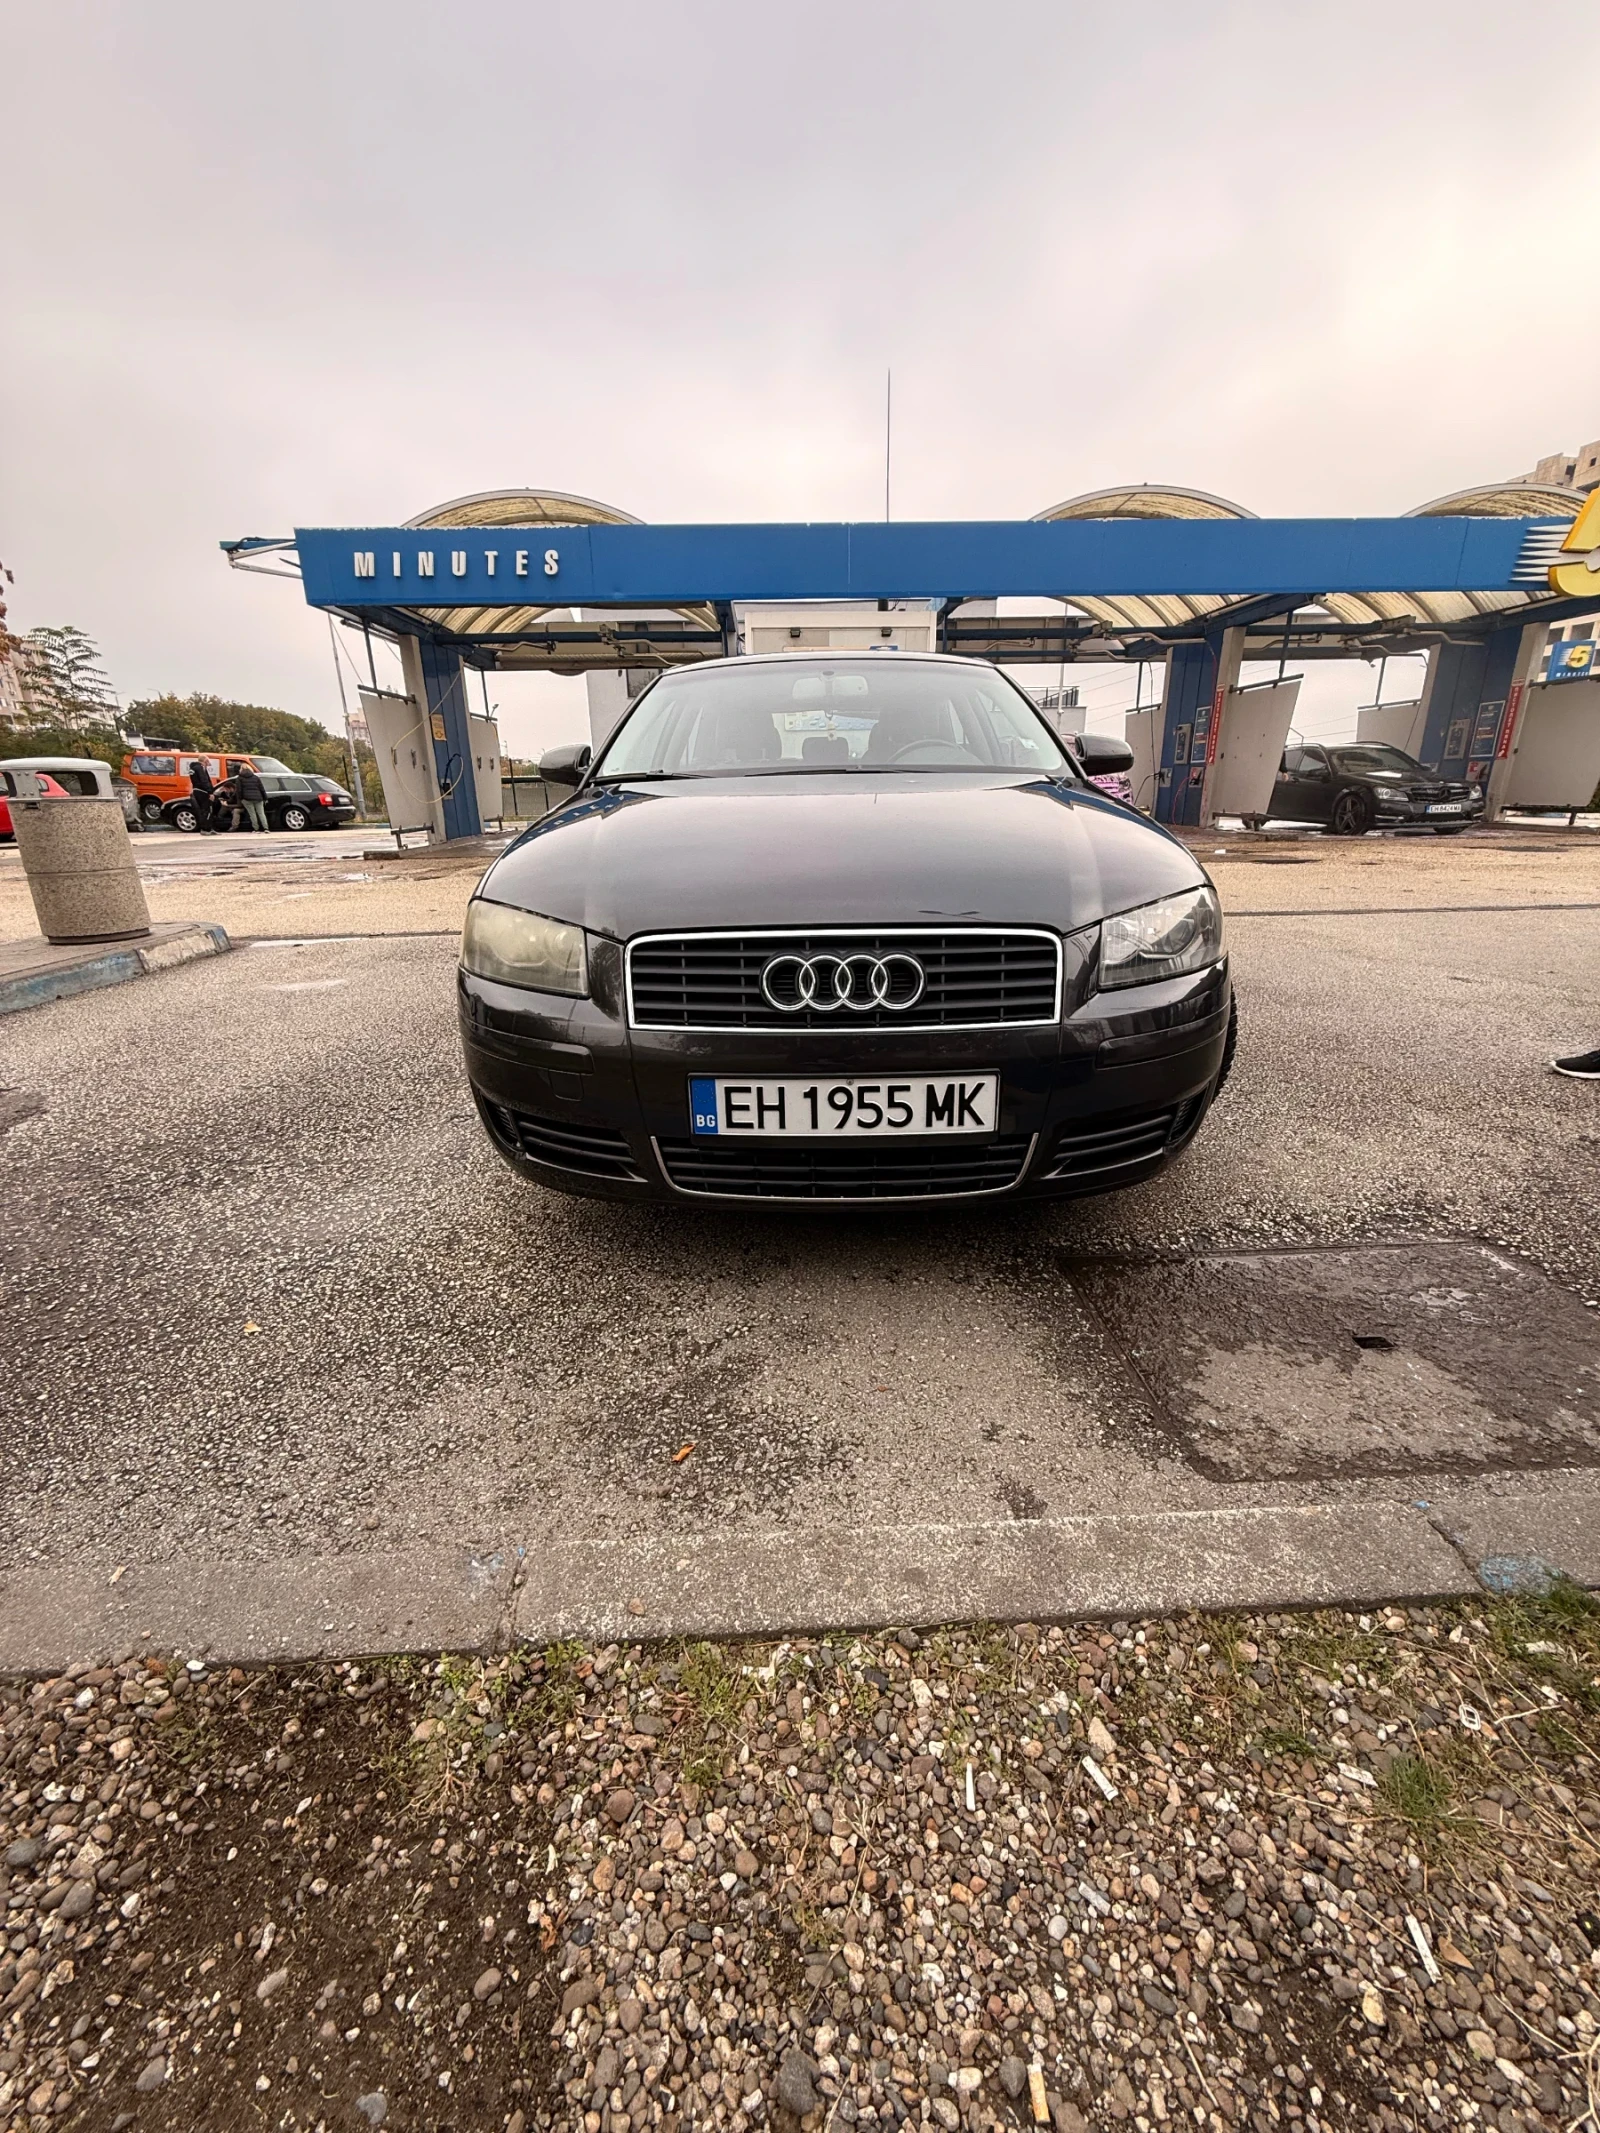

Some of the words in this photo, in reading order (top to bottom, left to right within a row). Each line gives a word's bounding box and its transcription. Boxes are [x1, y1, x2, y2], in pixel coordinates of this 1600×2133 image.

[353, 549, 560, 578] MINUTES
[1567, 645, 1592, 668] 5
[724, 1085, 787, 1130] EH
[803, 1084, 914, 1130] 1955
[925, 1082, 986, 1128] MK
[696, 1115, 716, 1127] BG
